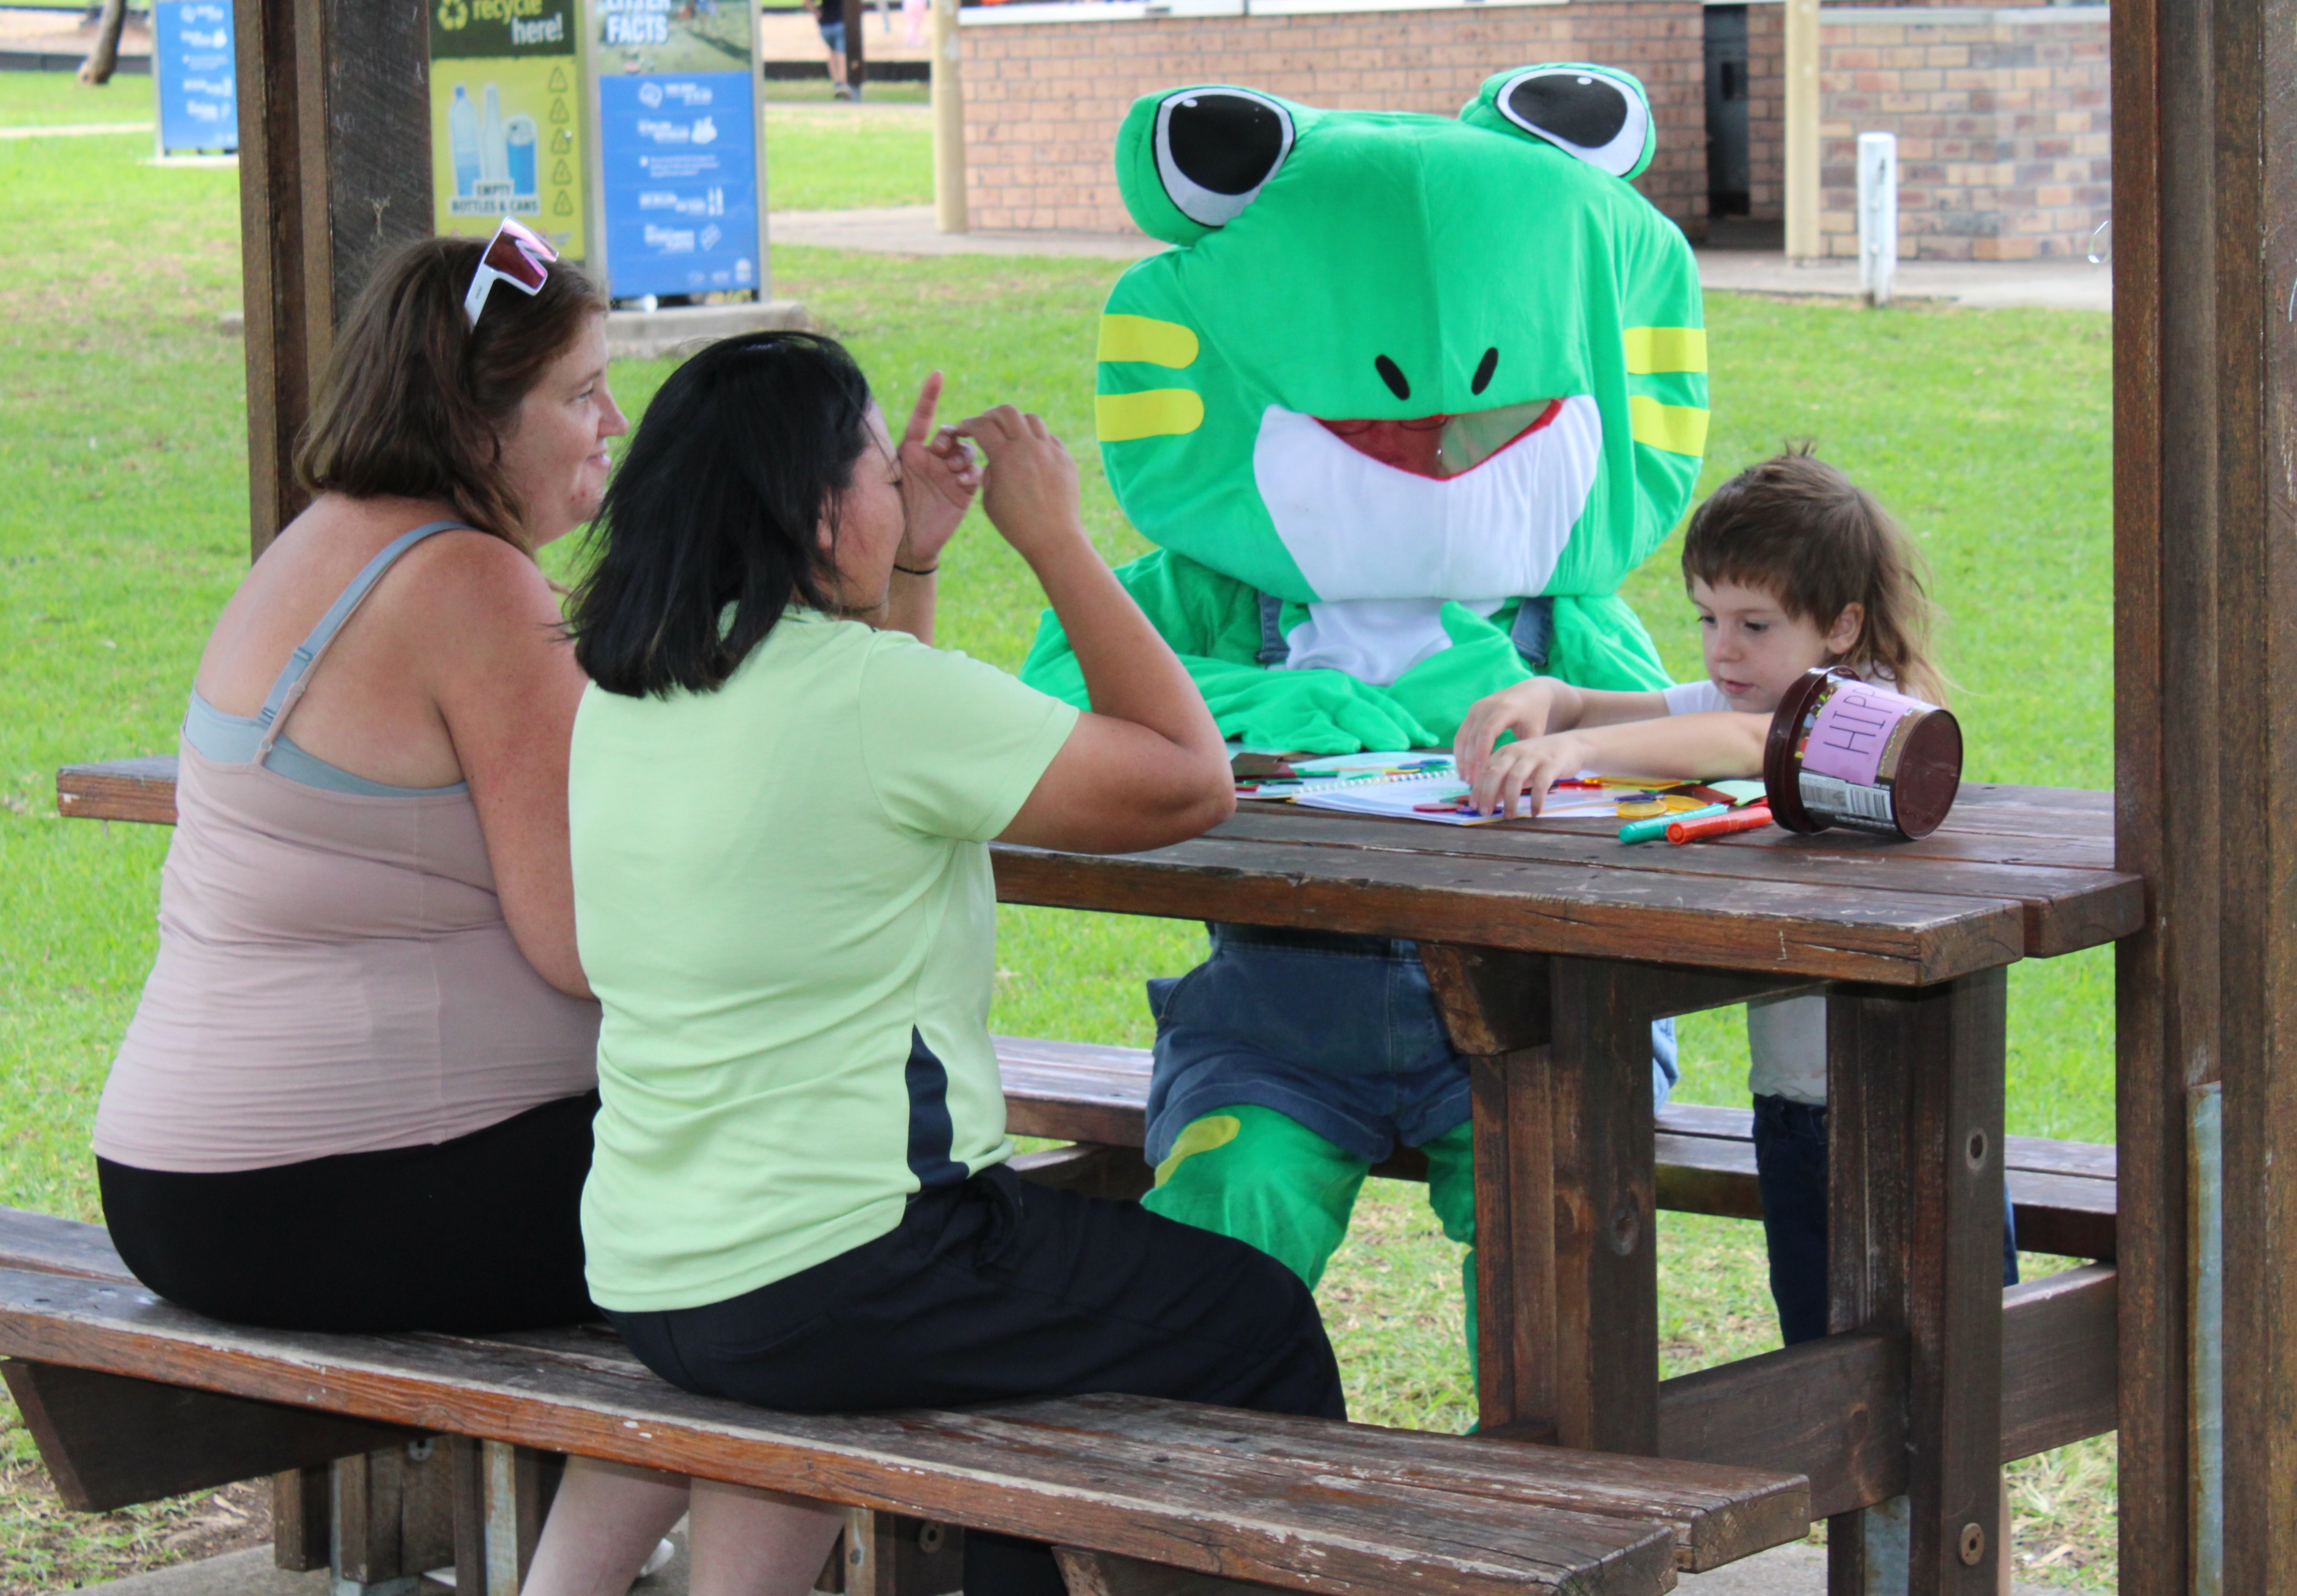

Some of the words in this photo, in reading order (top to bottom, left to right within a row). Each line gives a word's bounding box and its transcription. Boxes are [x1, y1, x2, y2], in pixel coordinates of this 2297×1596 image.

[472, 0, 541, 24] recycle
[512, 12, 563, 45] here!
[607, 15, 668, 43] FACTS
[476, 184, 511, 194] EMPTY
[452, 199, 496, 212] BOTTLES
[510, 199, 539, 212] CANS
